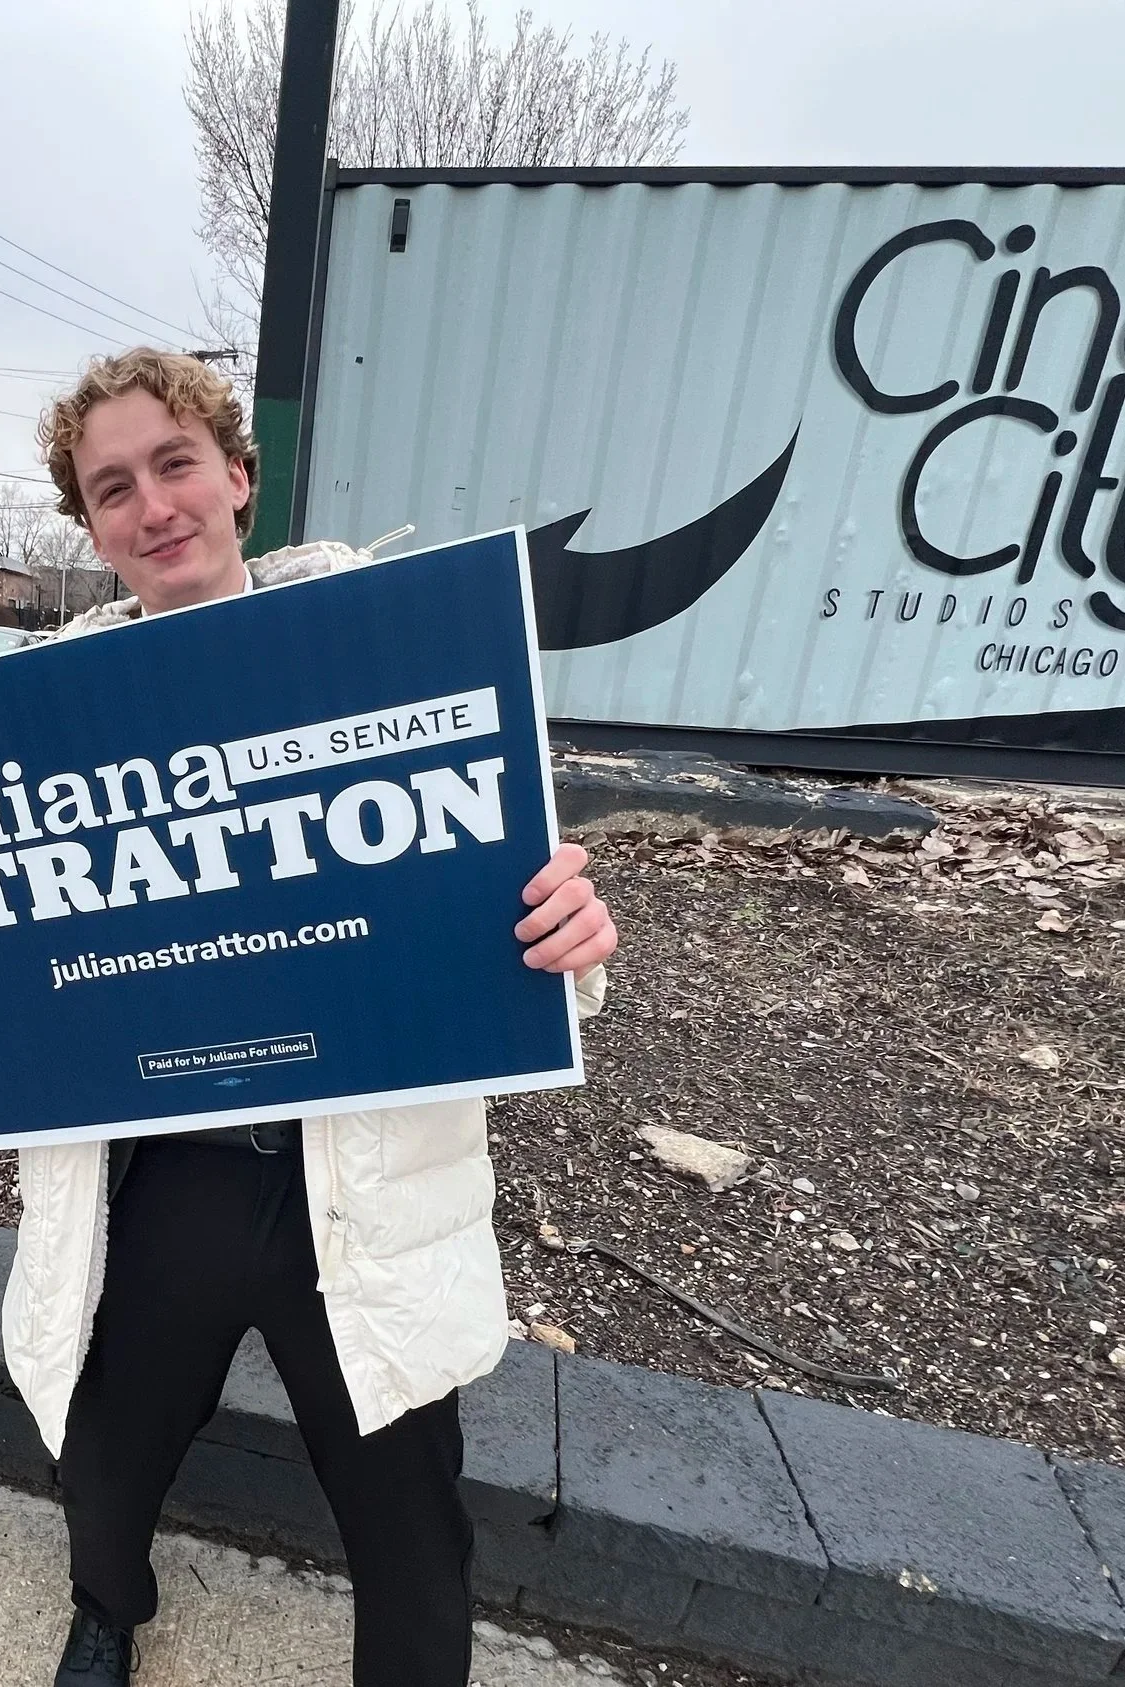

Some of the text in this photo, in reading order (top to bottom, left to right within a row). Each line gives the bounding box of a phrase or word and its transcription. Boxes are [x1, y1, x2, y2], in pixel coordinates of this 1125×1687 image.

[834, 218, 1125, 414] Cin
[822, 588, 1073, 629] STUDIOS
[979, 643, 1119, 678] CHICAGO
[247, 703, 472, 770] U.S. SENATE
[50, 916, 370, 990] julianastratton.com
[148, 1041, 309, 1071] Paid for by Juliana For Illinois
